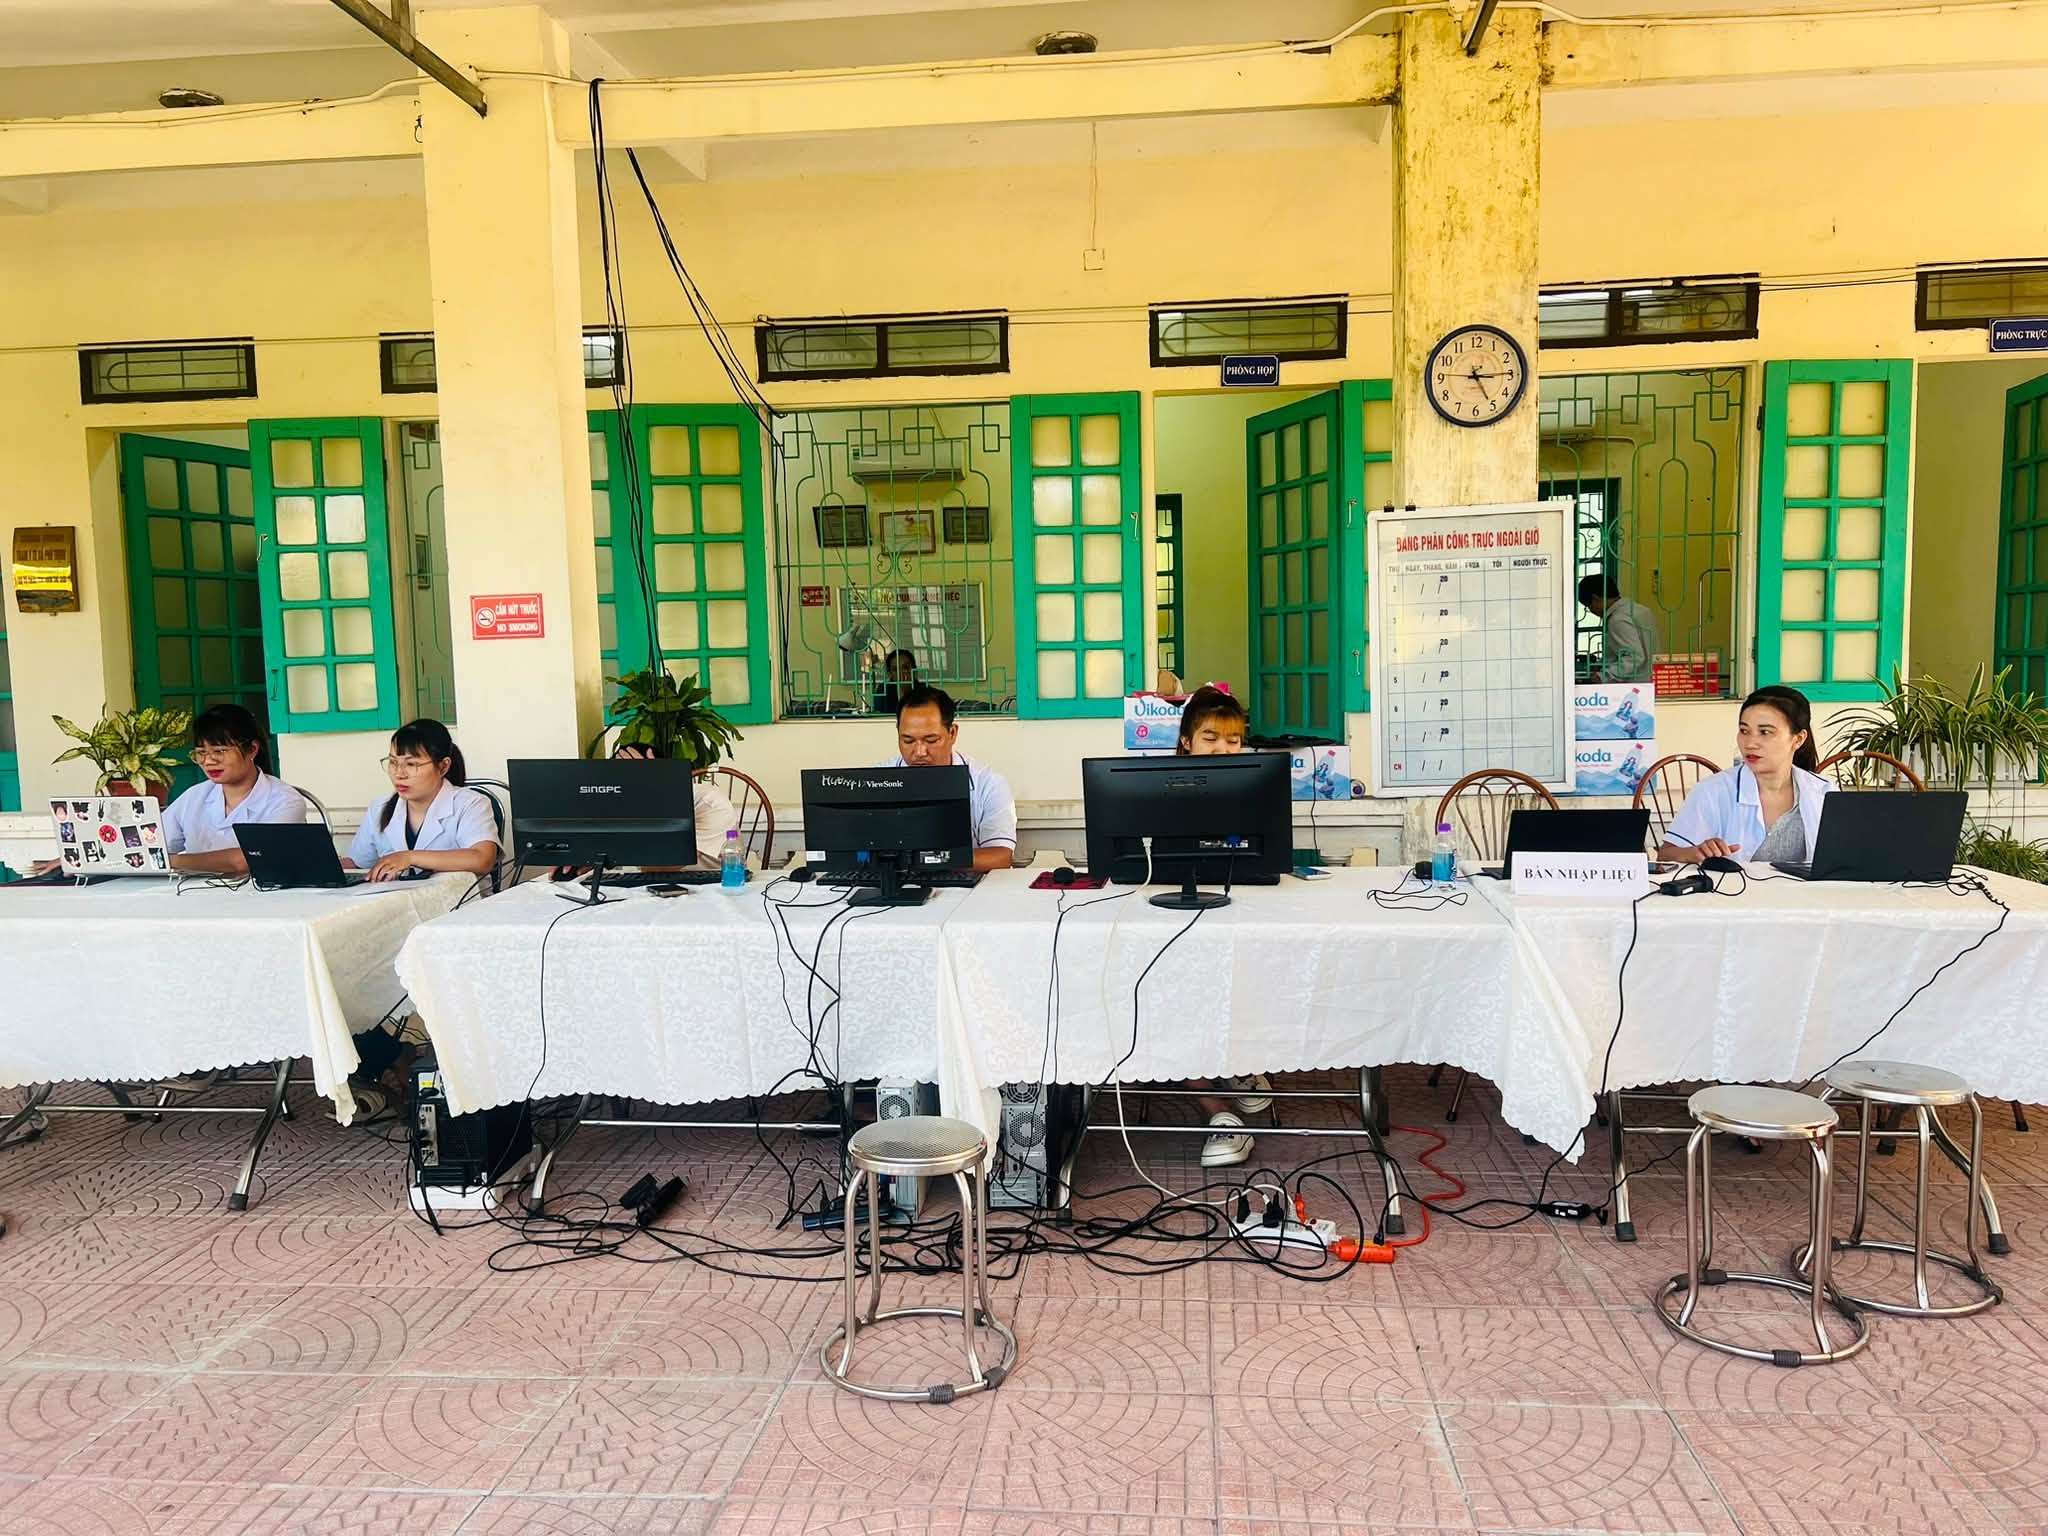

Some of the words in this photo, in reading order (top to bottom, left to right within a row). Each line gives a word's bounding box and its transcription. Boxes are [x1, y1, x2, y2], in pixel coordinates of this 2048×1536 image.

[1996, 329, 2023, 340] PHÒNG
[2025, 328, 2048, 340] TRỰC
[1454, 342, 1463, 353] 11
[1471, 336, 1483, 348] 12
[1492, 341, 1496, 351] 1
[1441, 355, 1453, 366] 10
[1503, 352, 1510, 363] 2
[1226, 364, 1255, 375] PHÒNG
[1257, 366, 1274, 377] HỌP
[1507, 369, 1514, 381] 3
[1437, 373, 1445, 384] 9
[1442, 390, 1449, 401] 8
[1502, 387, 1509, 398] 4
[1455, 402, 1461, 413] 7
[1472, 405, 1479, 416] 6
[1489, 400, 1497, 411] 5
[1421, 531, 1444, 550] PHÂN
[1446, 530, 1470, 549] CÔNG
[1472, 531, 1494, 551] TRỰC
[1496, 527, 1522, 547] NGOÀI
[1524, 526, 1540, 545] GIỜ
[497, 624, 507, 633] NO
[509, 622, 538, 633] SMOKING
[866, 780, 904, 788] ViewSonic
